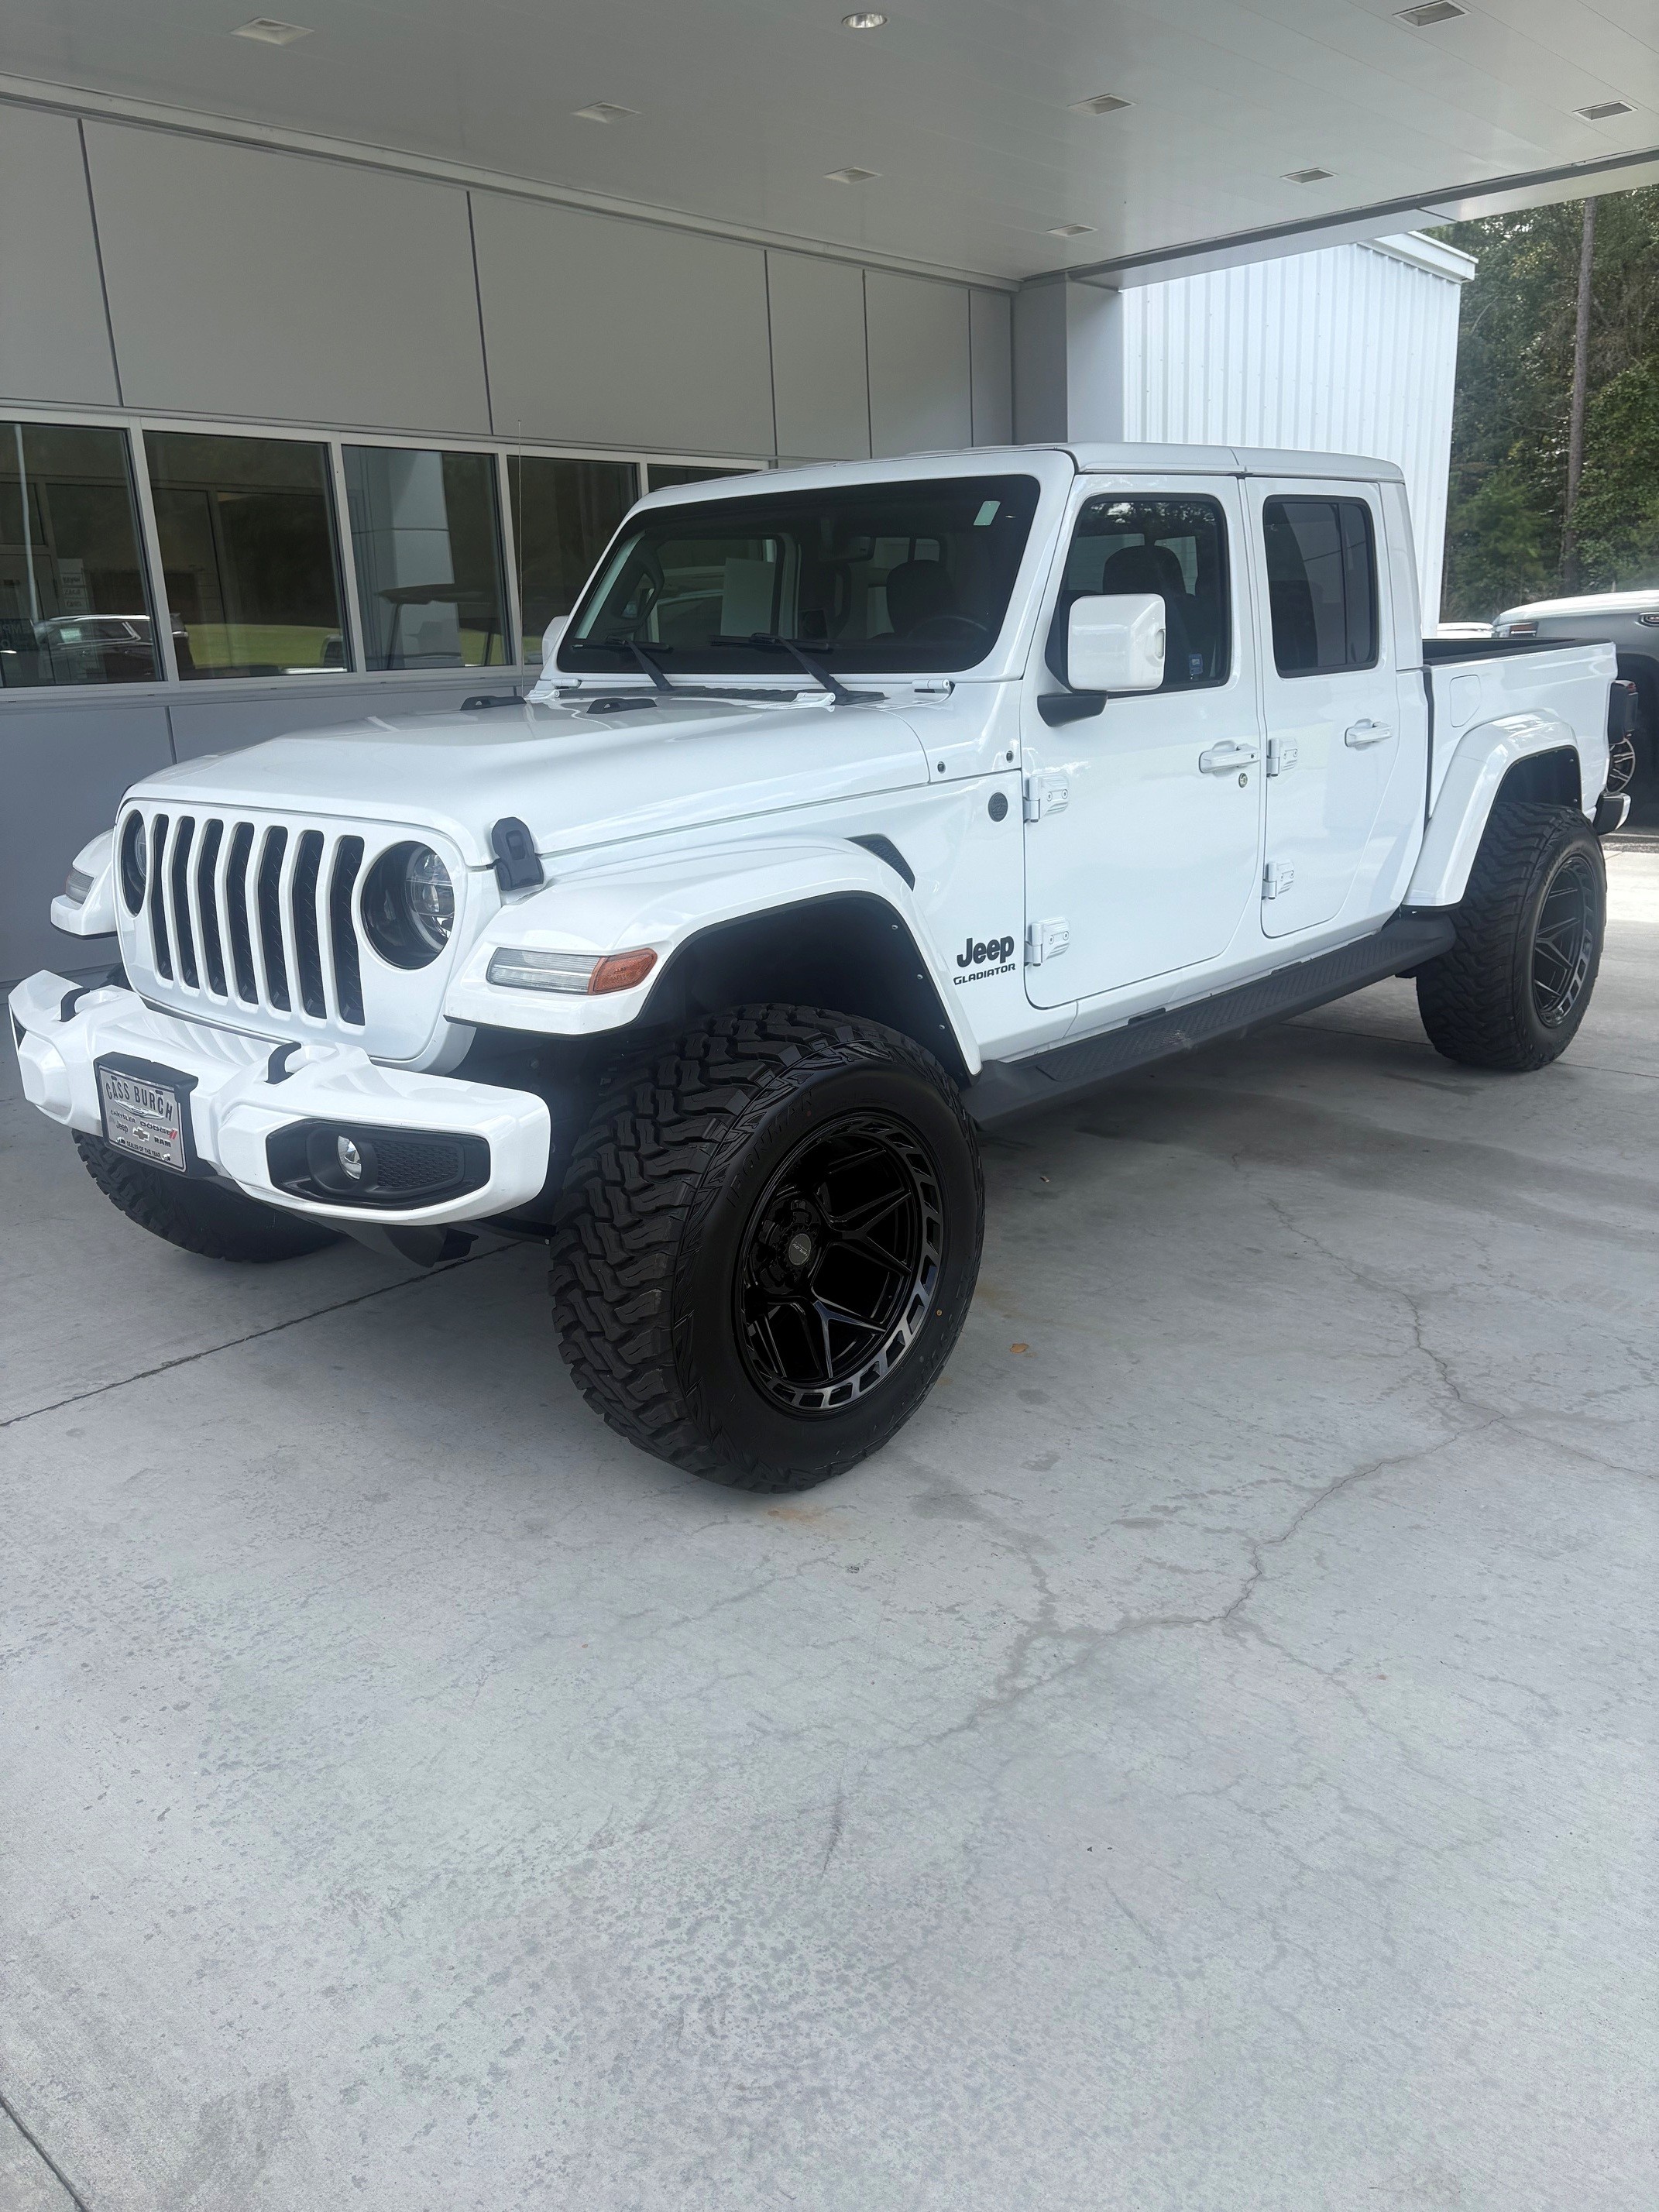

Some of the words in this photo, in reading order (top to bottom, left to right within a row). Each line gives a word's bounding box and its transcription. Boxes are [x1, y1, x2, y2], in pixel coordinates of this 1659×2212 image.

[957, 936, 1015, 967] Jeep
[953, 963, 1016, 985] GLADIATOR
[105, 1082, 130, 1100] CASS
[134, 1086, 173, 1121] BURCH
[110, 1110, 136, 1123] CHRYSLER
[139, 1121, 172, 1135] DODGE
[116, 1121, 129, 1134] Jeep
[154, 1136, 171, 1147] RAM
[126, 1141, 139, 1150] DEALER
